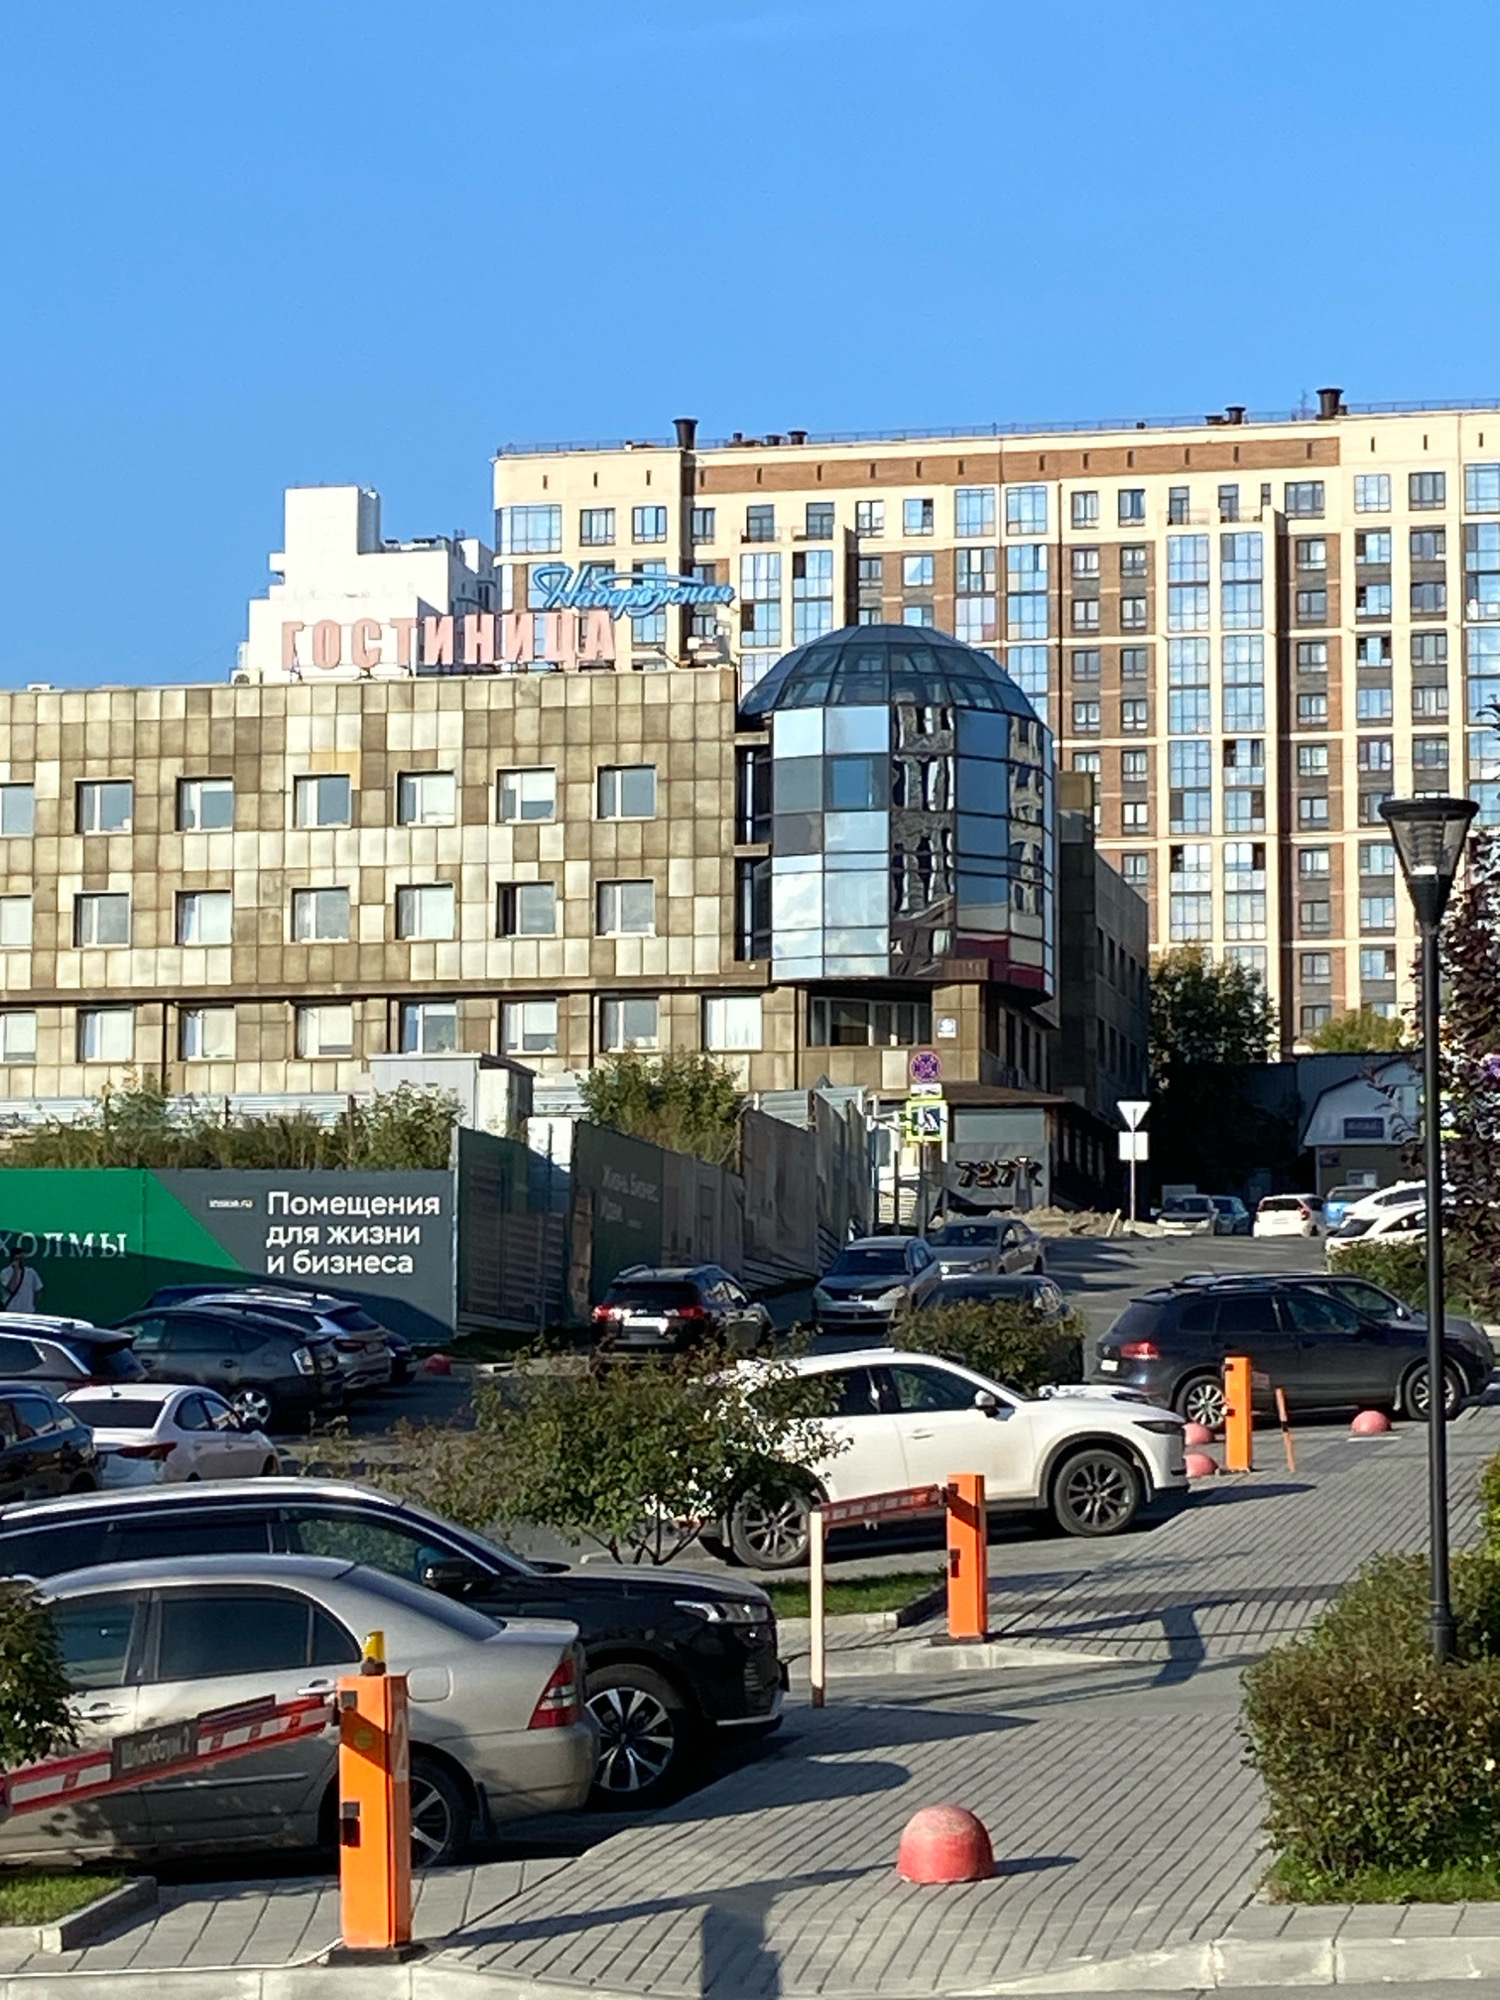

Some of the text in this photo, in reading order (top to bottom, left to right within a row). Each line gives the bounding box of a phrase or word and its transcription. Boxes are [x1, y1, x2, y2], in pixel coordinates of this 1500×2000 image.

[533, 564, 735, 621] Набережная
[282, 610, 616, 671] ГОСТИНИЦА
[267, 1191, 440, 1218] Помещения
[266, 1226, 420, 1248] для жизни
[267, 1250, 414, 1274] и бизнеса
